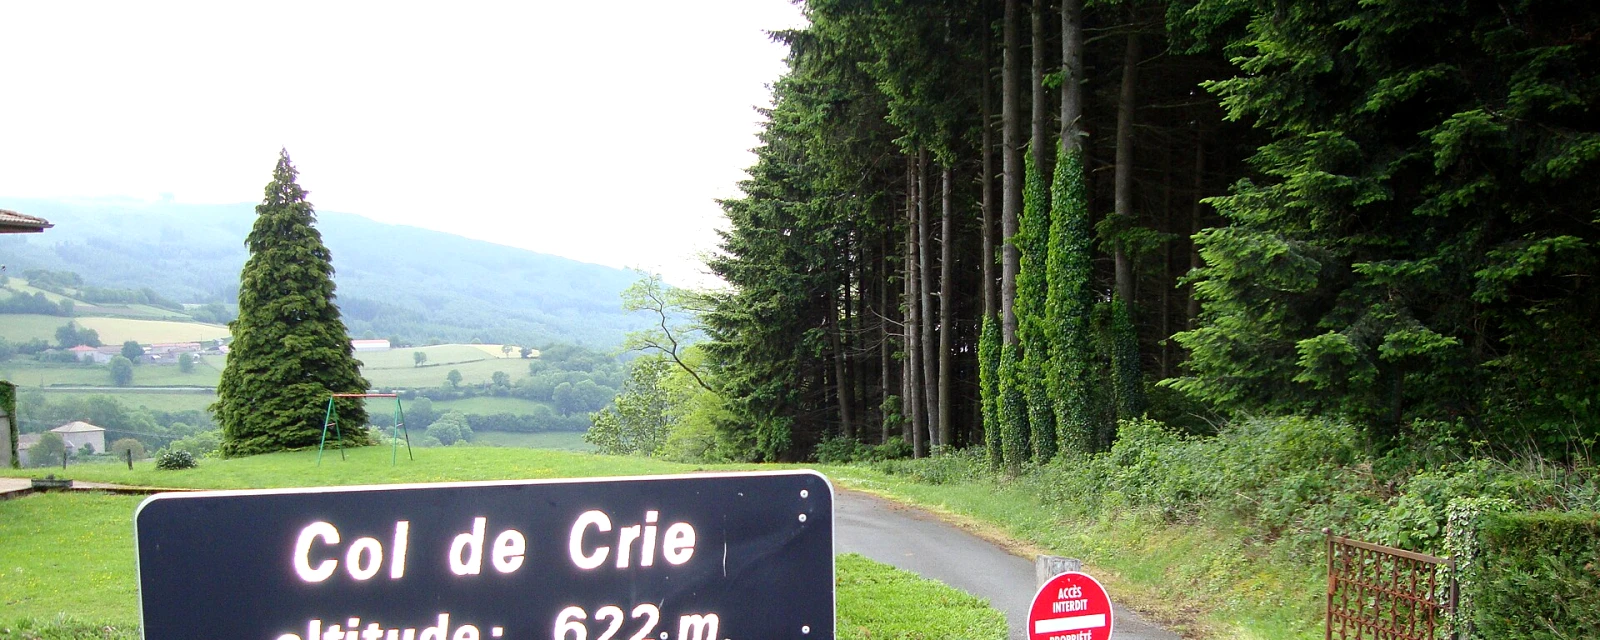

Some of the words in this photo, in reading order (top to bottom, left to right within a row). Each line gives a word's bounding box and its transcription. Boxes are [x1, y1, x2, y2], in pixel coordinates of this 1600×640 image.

[294, 520, 409, 582] Col
[449, 516, 526, 575] de
[569, 510, 696, 569] Crie
[1058, 584, 1082, 599] ACCÈS
[1053, 599, 1088, 613] INTERDIT
[554, 603, 660, 640] 622
[678, 613, 731, 640] m
